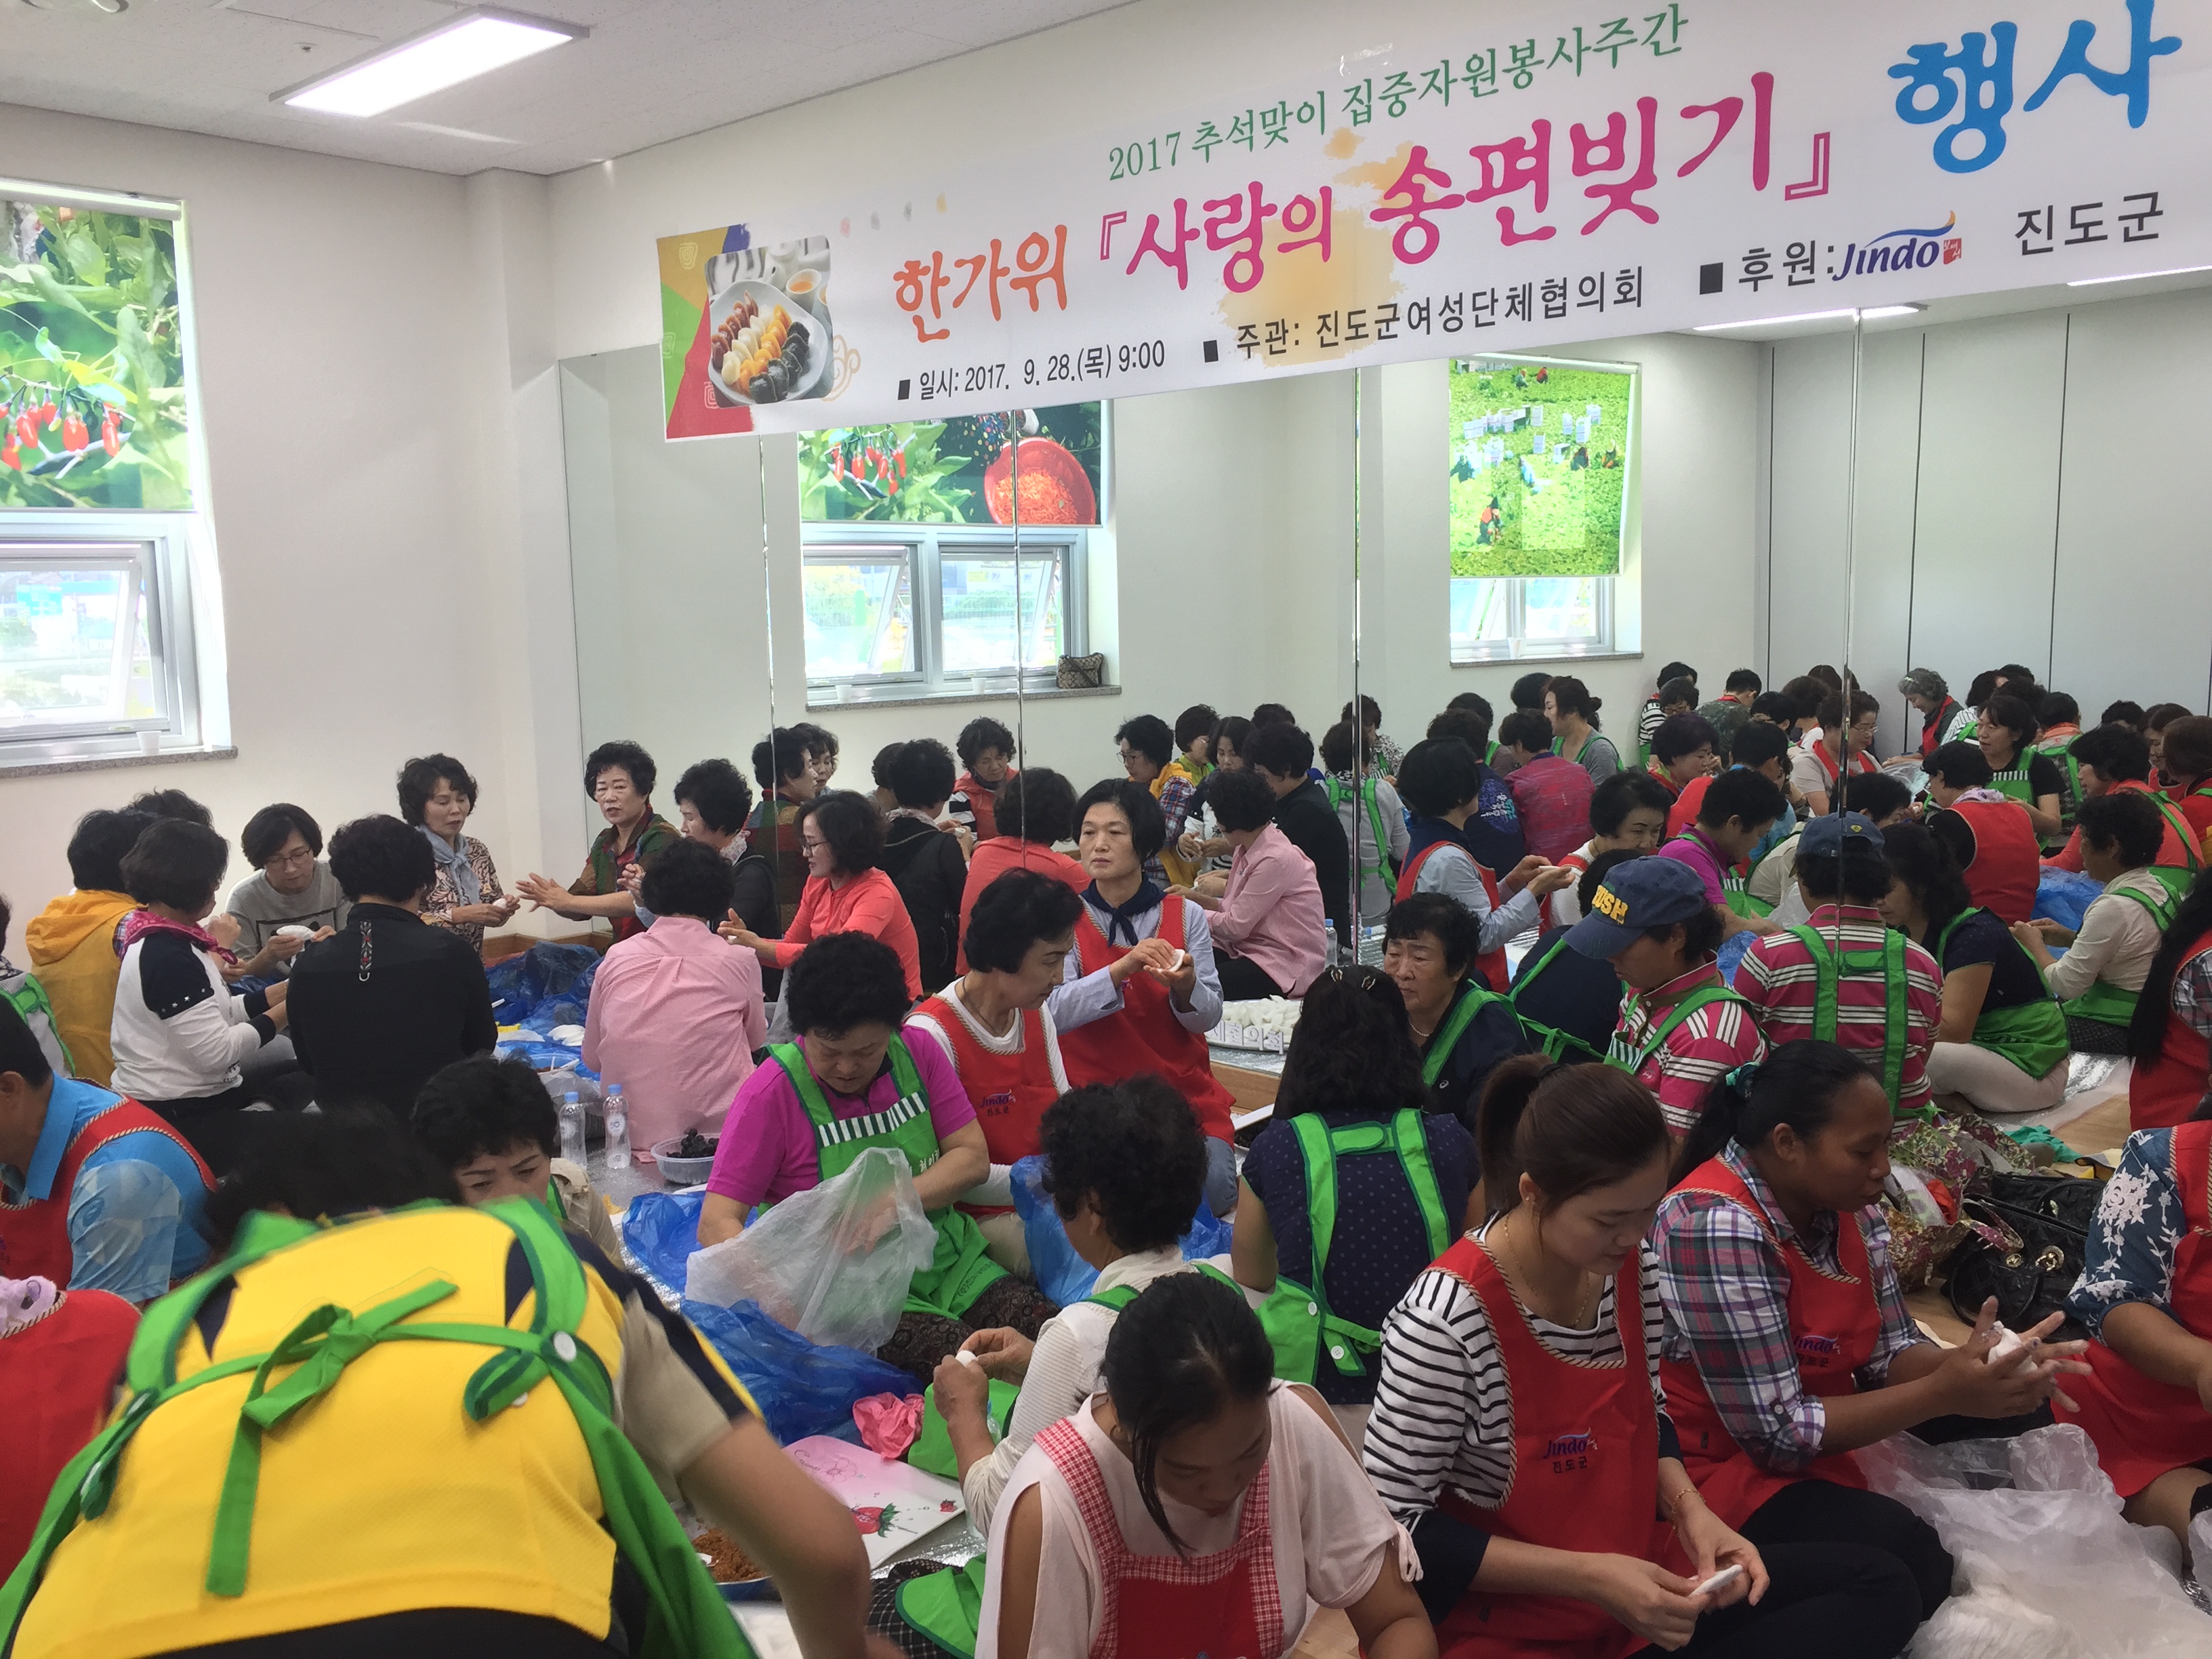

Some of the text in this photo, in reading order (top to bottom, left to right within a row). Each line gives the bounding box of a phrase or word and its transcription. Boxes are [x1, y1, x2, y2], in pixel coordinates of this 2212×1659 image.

[1110, 3, 1689, 180] 2017 추석맞이 집중자원봉사주간
[893, 0, 2182, 343] 한가위 『사랑의 송편빚기』 행사
[1738, 240, 1835, 292] 후원:
[1832, 237, 1940, 282] Jindo
[2015, 191, 2164, 256] 진도군
[1236, 264, 1644, 357] 주관: 진도군여성단체협의회
[1119, 340, 1165, 372] 9:00
[979, 1096, 1009, 1108] Jindo
[1543, 1438, 1587, 1459] Jindo
[1553, 1456, 1588, 1474] 진도군
